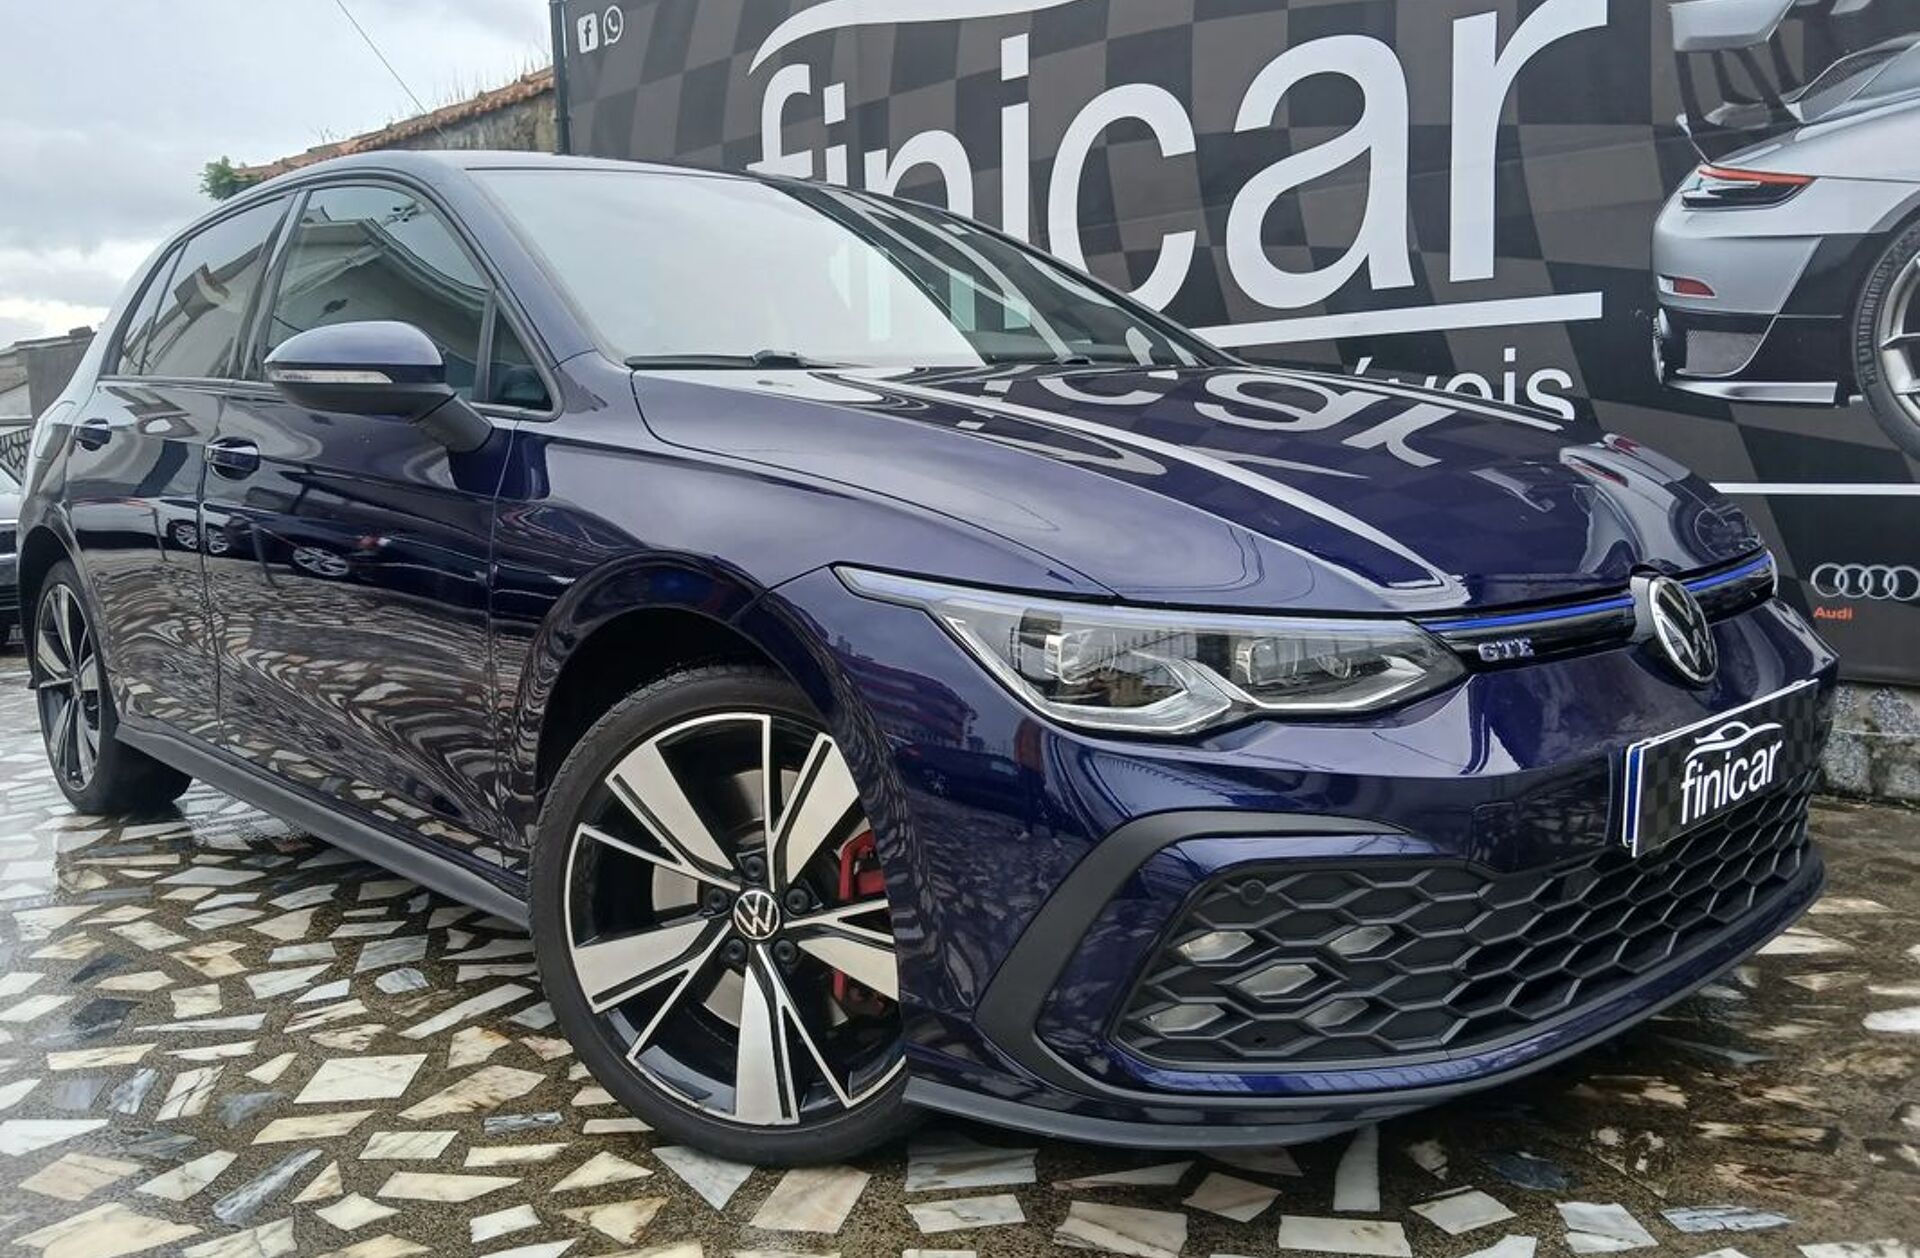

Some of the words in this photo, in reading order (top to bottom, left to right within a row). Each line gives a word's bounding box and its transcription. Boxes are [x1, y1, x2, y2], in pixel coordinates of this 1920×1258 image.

[1813, 606, 1853, 620] Audi
[1478, 638, 1535, 662] GTE
[1681, 740, 1783, 825] finicar
